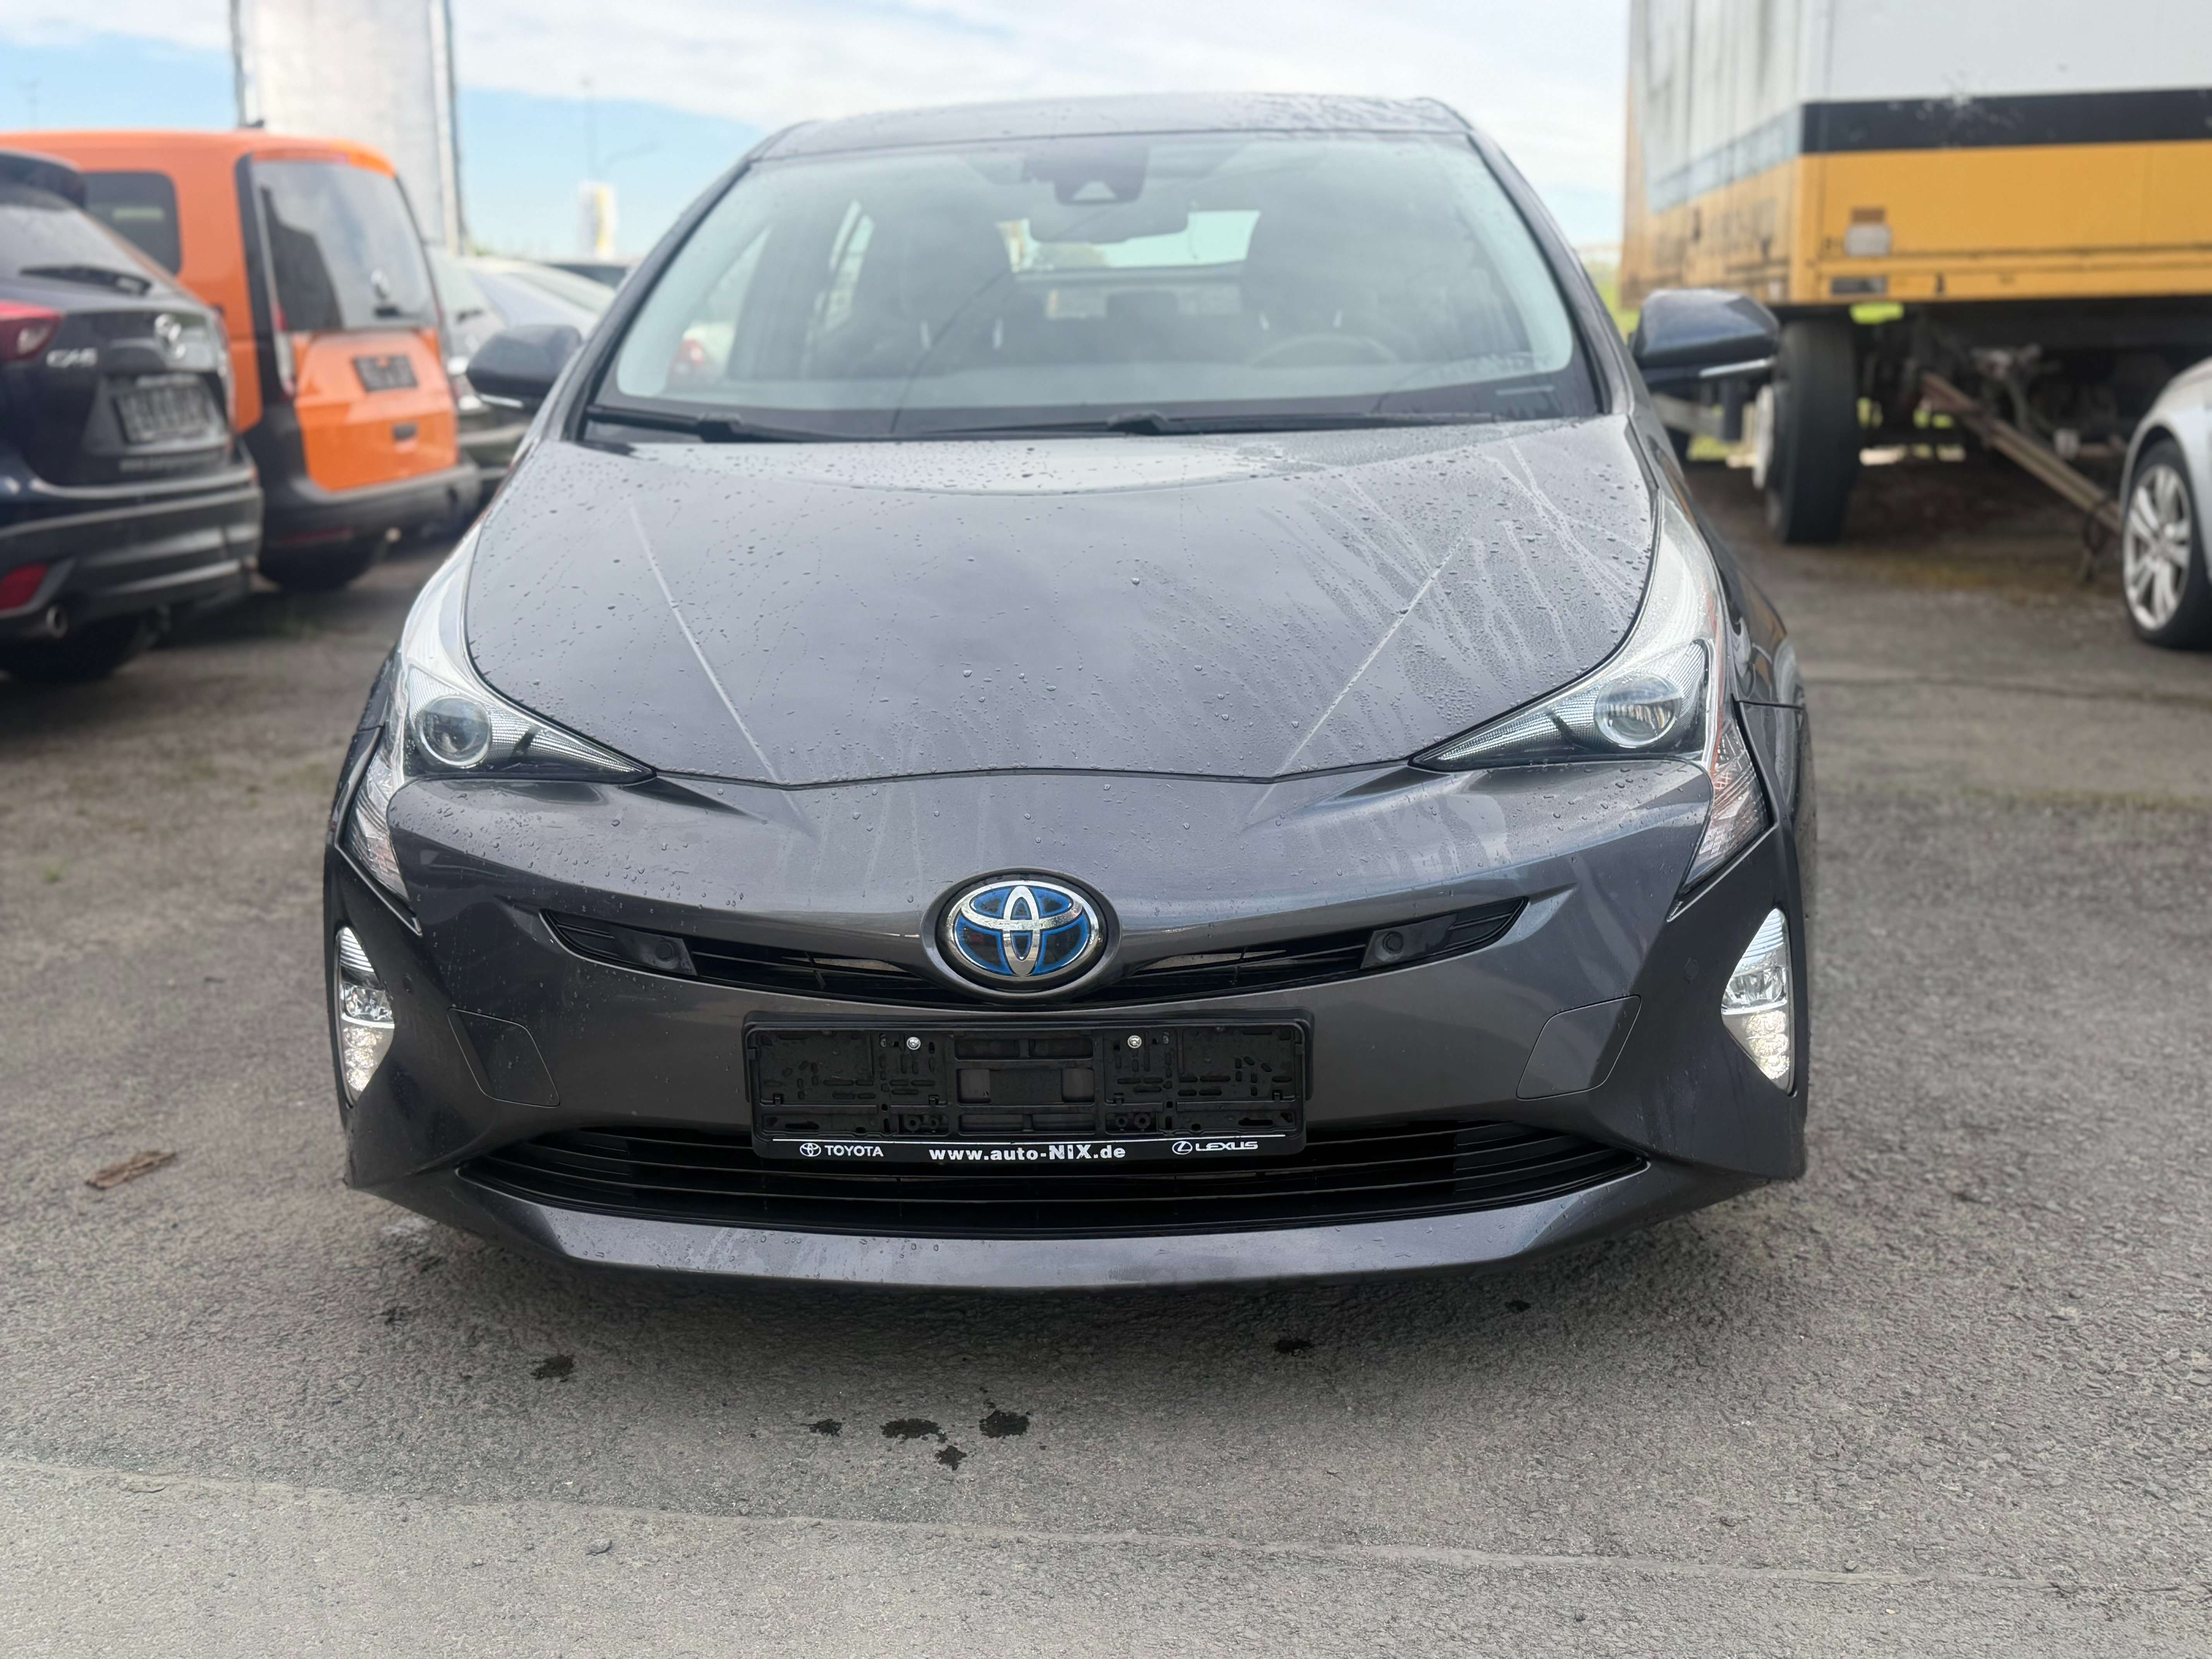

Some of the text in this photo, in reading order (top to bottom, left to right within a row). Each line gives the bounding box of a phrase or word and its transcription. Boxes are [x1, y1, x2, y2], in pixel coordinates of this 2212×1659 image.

[824, 1145, 884, 1157] TOYOTA
[1195, 1141, 1258, 1151] LEXUS
[929, 1144, 1126, 1161] www.auto-NIX.de
